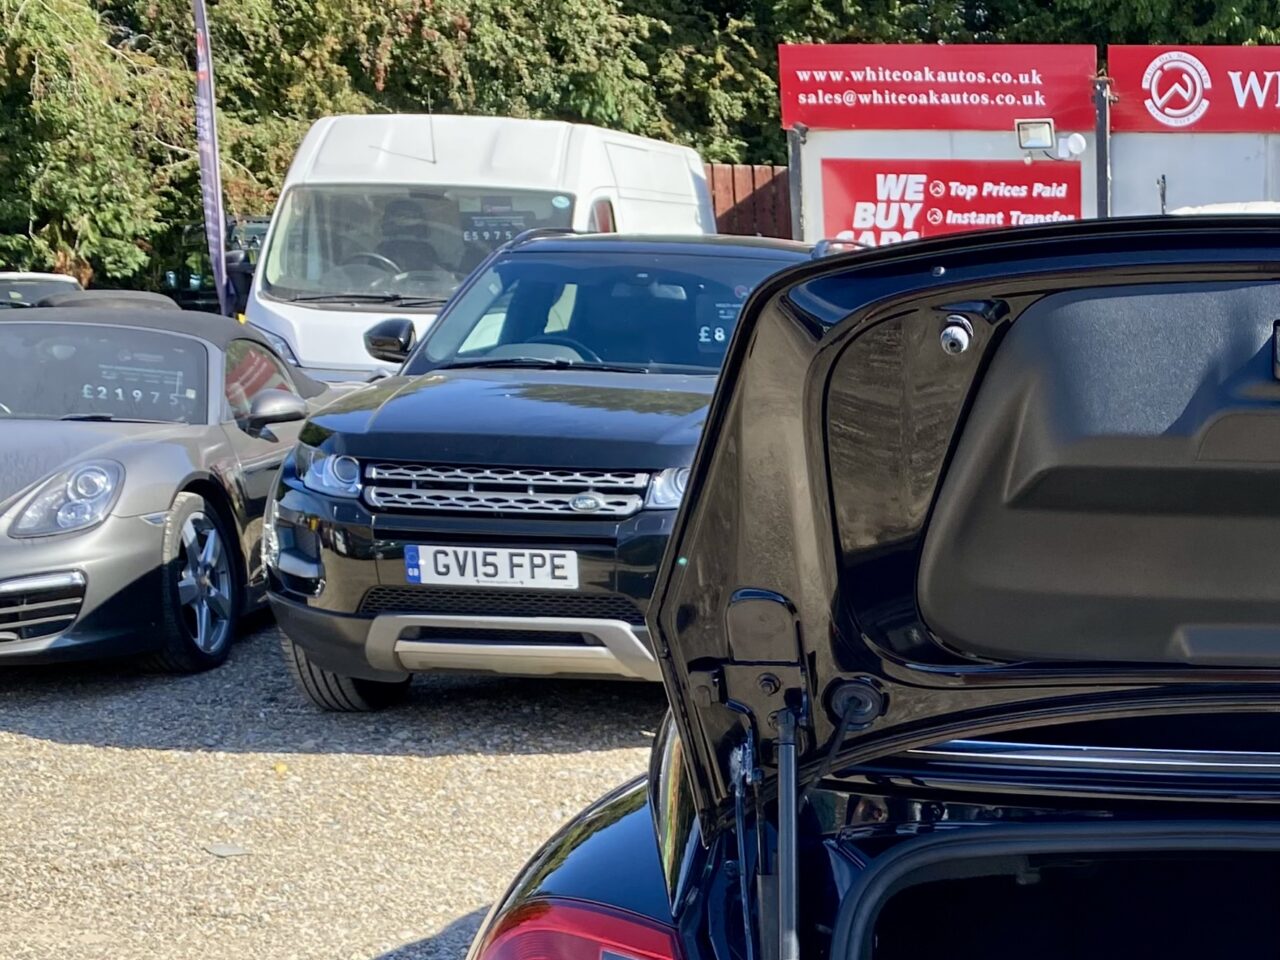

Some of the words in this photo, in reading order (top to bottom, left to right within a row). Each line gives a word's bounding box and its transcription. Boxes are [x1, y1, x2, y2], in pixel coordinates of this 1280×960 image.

[796, 67, 1042, 85] www.whiteoakautos.co.uk
[797, 89, 1046, 106] sales@whiteoakautos.co.uk
[876, 174, 927, 201] WE
[949, 181, 978, 201] Top
[982, 182, 1028, 197] Prices
[1032, 182, 1068, 198] Paid
[853, 202, 924, 229] BUY
[946, 210, 1004, 225] Instant
[433, 549, 499, 578] GV15
[508, 551, 568, 580] FPE
